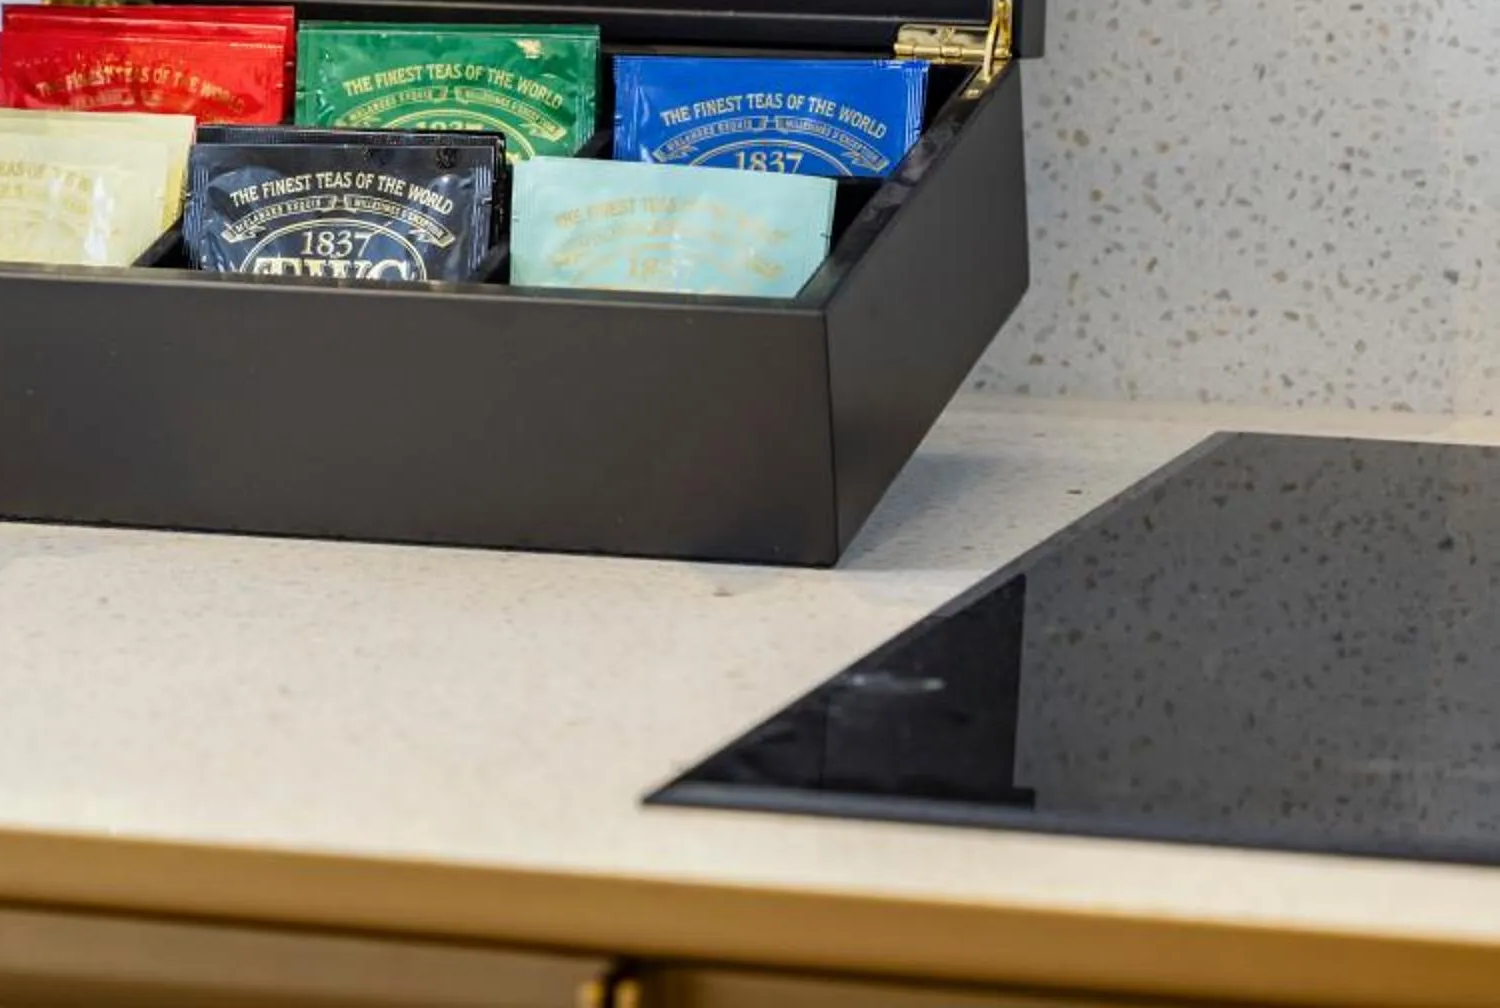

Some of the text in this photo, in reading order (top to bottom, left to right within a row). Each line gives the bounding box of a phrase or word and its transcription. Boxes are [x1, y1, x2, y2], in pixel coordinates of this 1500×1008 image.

[342, 63, 564, 111] THE FINEST TEAS OF THE WORLD
[659, 93, 888, 140] THE FINEST TEAS OF THE WORLD
[735, 150, 805, 175] 1837
[230, 171, 454, 215] THE FINEST TEAS OF THE WORLD
[301, 230, 372, 259] 1837
